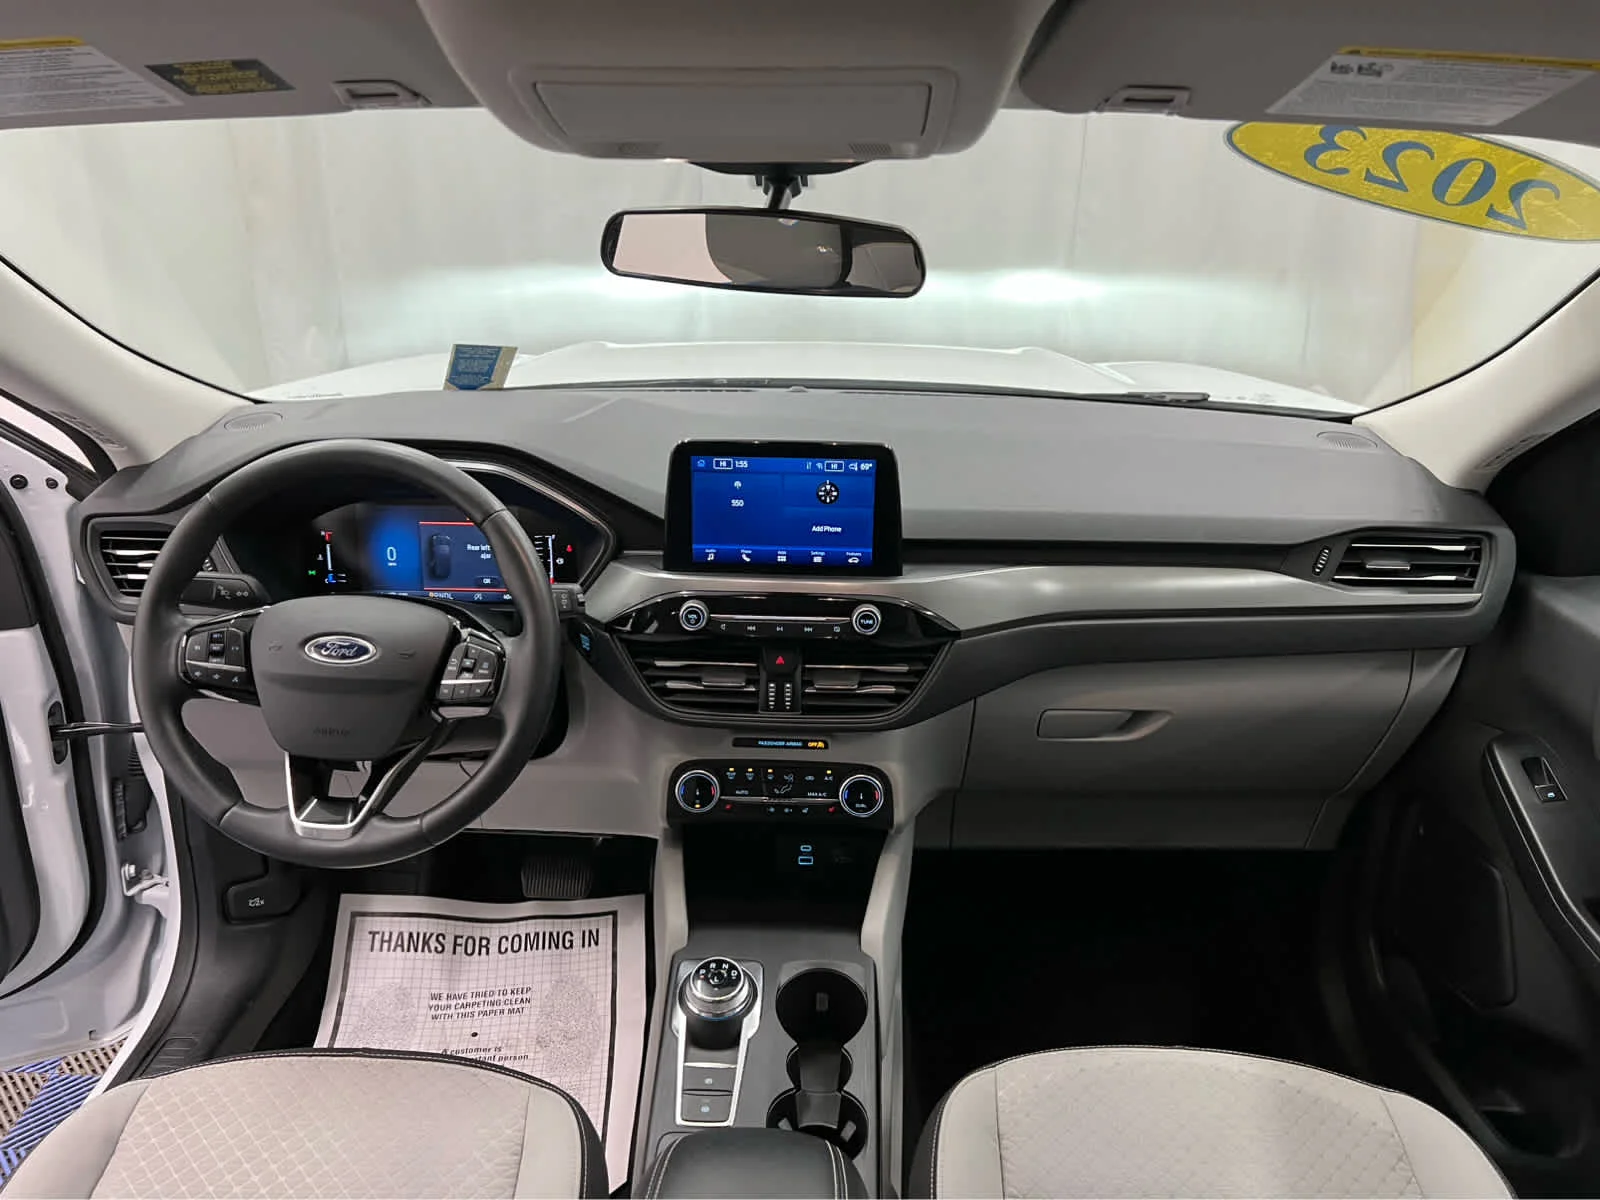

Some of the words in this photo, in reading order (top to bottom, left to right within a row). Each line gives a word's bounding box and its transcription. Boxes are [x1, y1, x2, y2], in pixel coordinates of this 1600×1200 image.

[321, 641, 358, 656] Ford
[368, 930, 446, 954] THANKS
[452, 934, 491, 957] FOR
[498, 930, 574, 955] COMING
[582, 927, 600, 949] IN
[430, 991, 444, 1001] WE
[446, 991, 469, 1001] HAVE
[470, 989, 496, 999] TRIED
[498, 988, 508, 997] TO
[510, 986, 532, 995] KEEP
[428, 1002, 452, 1012] YOUR
[454, 998, 502, 1010] CARPETING
[504, 997, 531, 1006] CLEAN
[431, 1012, 453, 1021] WITH
[456, 1010, 475, 1020] THIS
[478, 1008, 505, 1018] PAPER
[507, 1006, 525, 1015] MAT
[450, 1046, 492, 1056] customer
